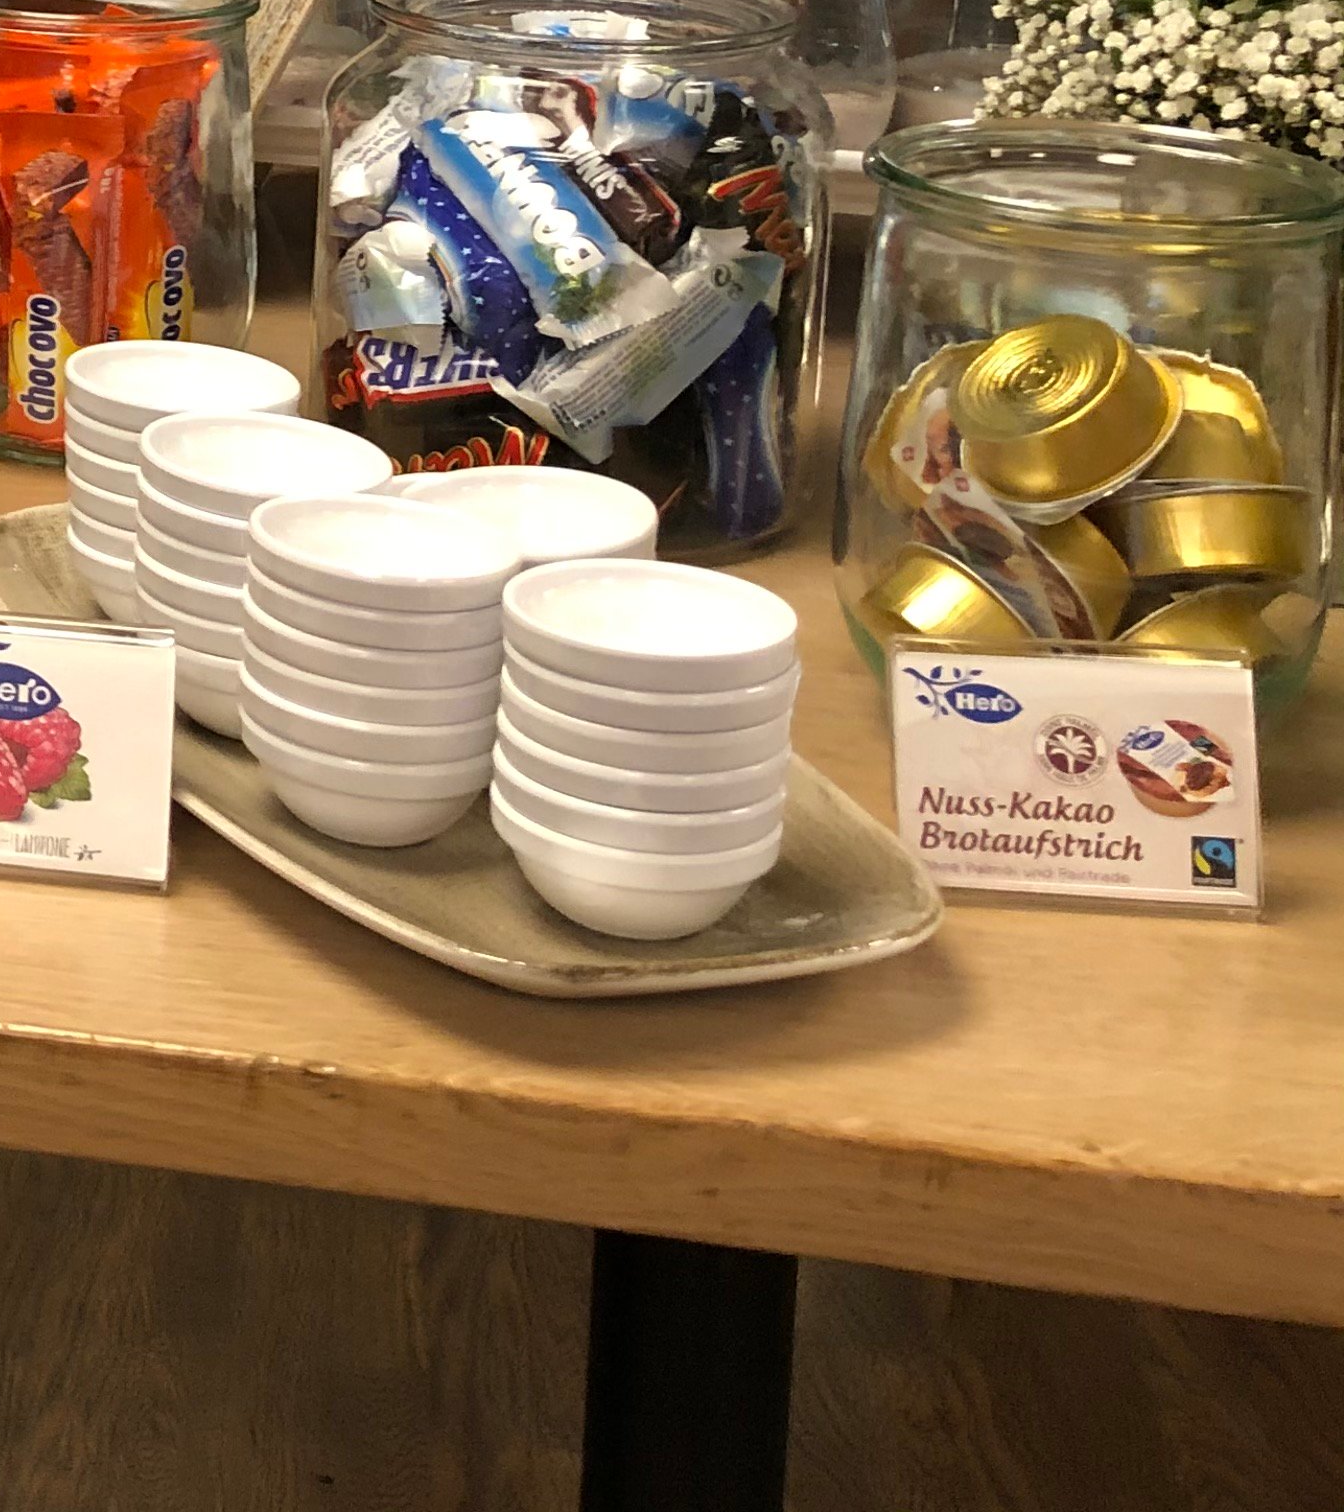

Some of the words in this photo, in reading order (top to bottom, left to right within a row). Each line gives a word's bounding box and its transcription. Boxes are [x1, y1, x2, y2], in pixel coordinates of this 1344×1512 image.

[954, 691, 1016, 713] Hero
[917, 786, 1116, 825] Nuss-Kakao
[918, 820, 1145, 863] Brotaufstrich
